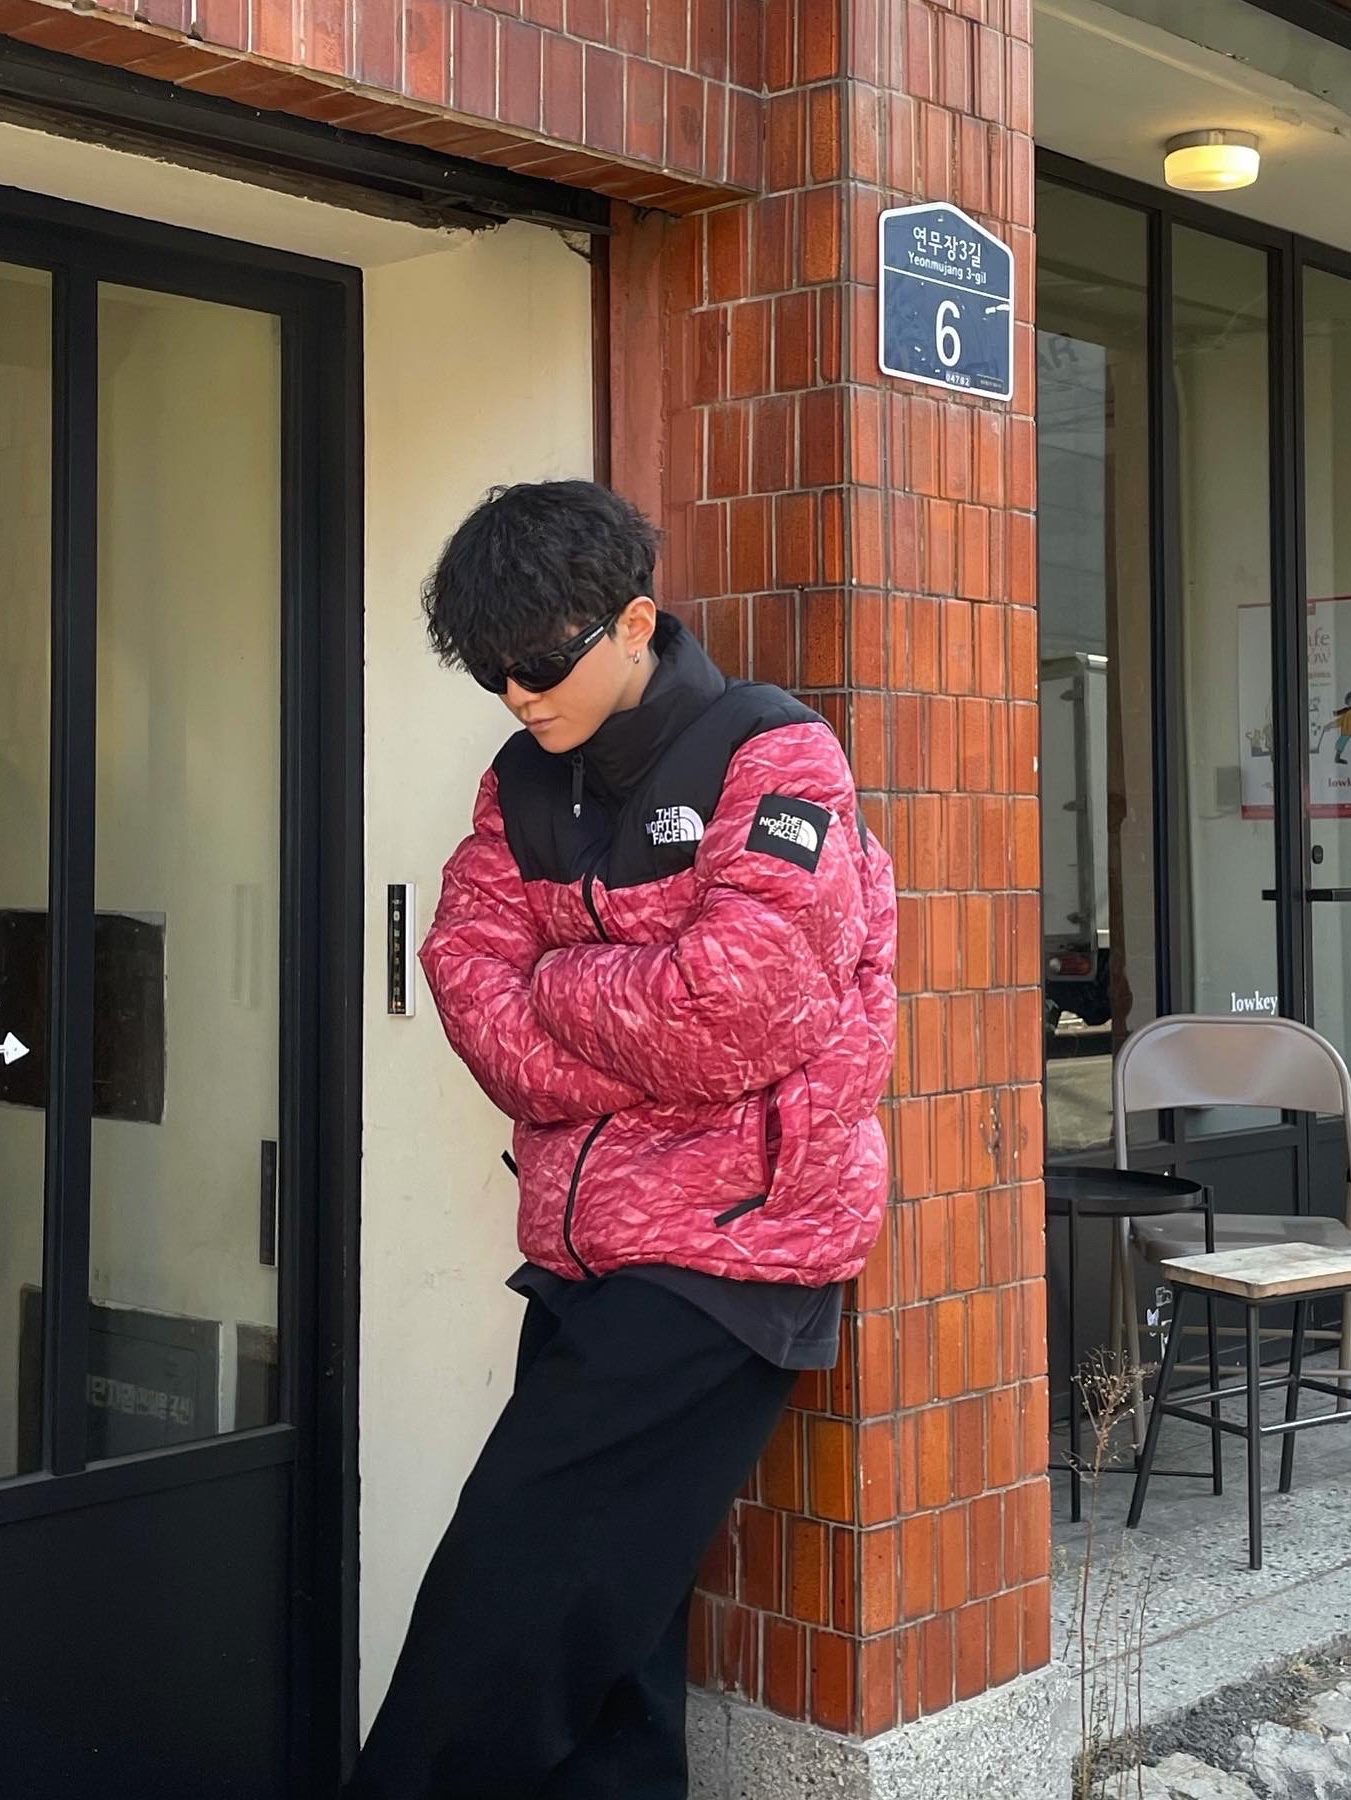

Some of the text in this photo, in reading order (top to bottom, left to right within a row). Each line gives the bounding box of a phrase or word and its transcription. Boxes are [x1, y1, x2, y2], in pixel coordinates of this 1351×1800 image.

[913, 227, 980, 268] 연무장3길
[908, 251, 987, 285] Yeonmujang 3-gil
[936, 300, 961, 367] 6
[655, 806, 679, 820] THE
[780, 812, 802, 825] THE
[645, 819, 680, 834] NORTH
[759, 816, 800, 834] NORTH
[653, 831, 680, 845] FACE
[768, 826, 798, 843] FACE
[1231, 990, 1278, 1015] lowkey
